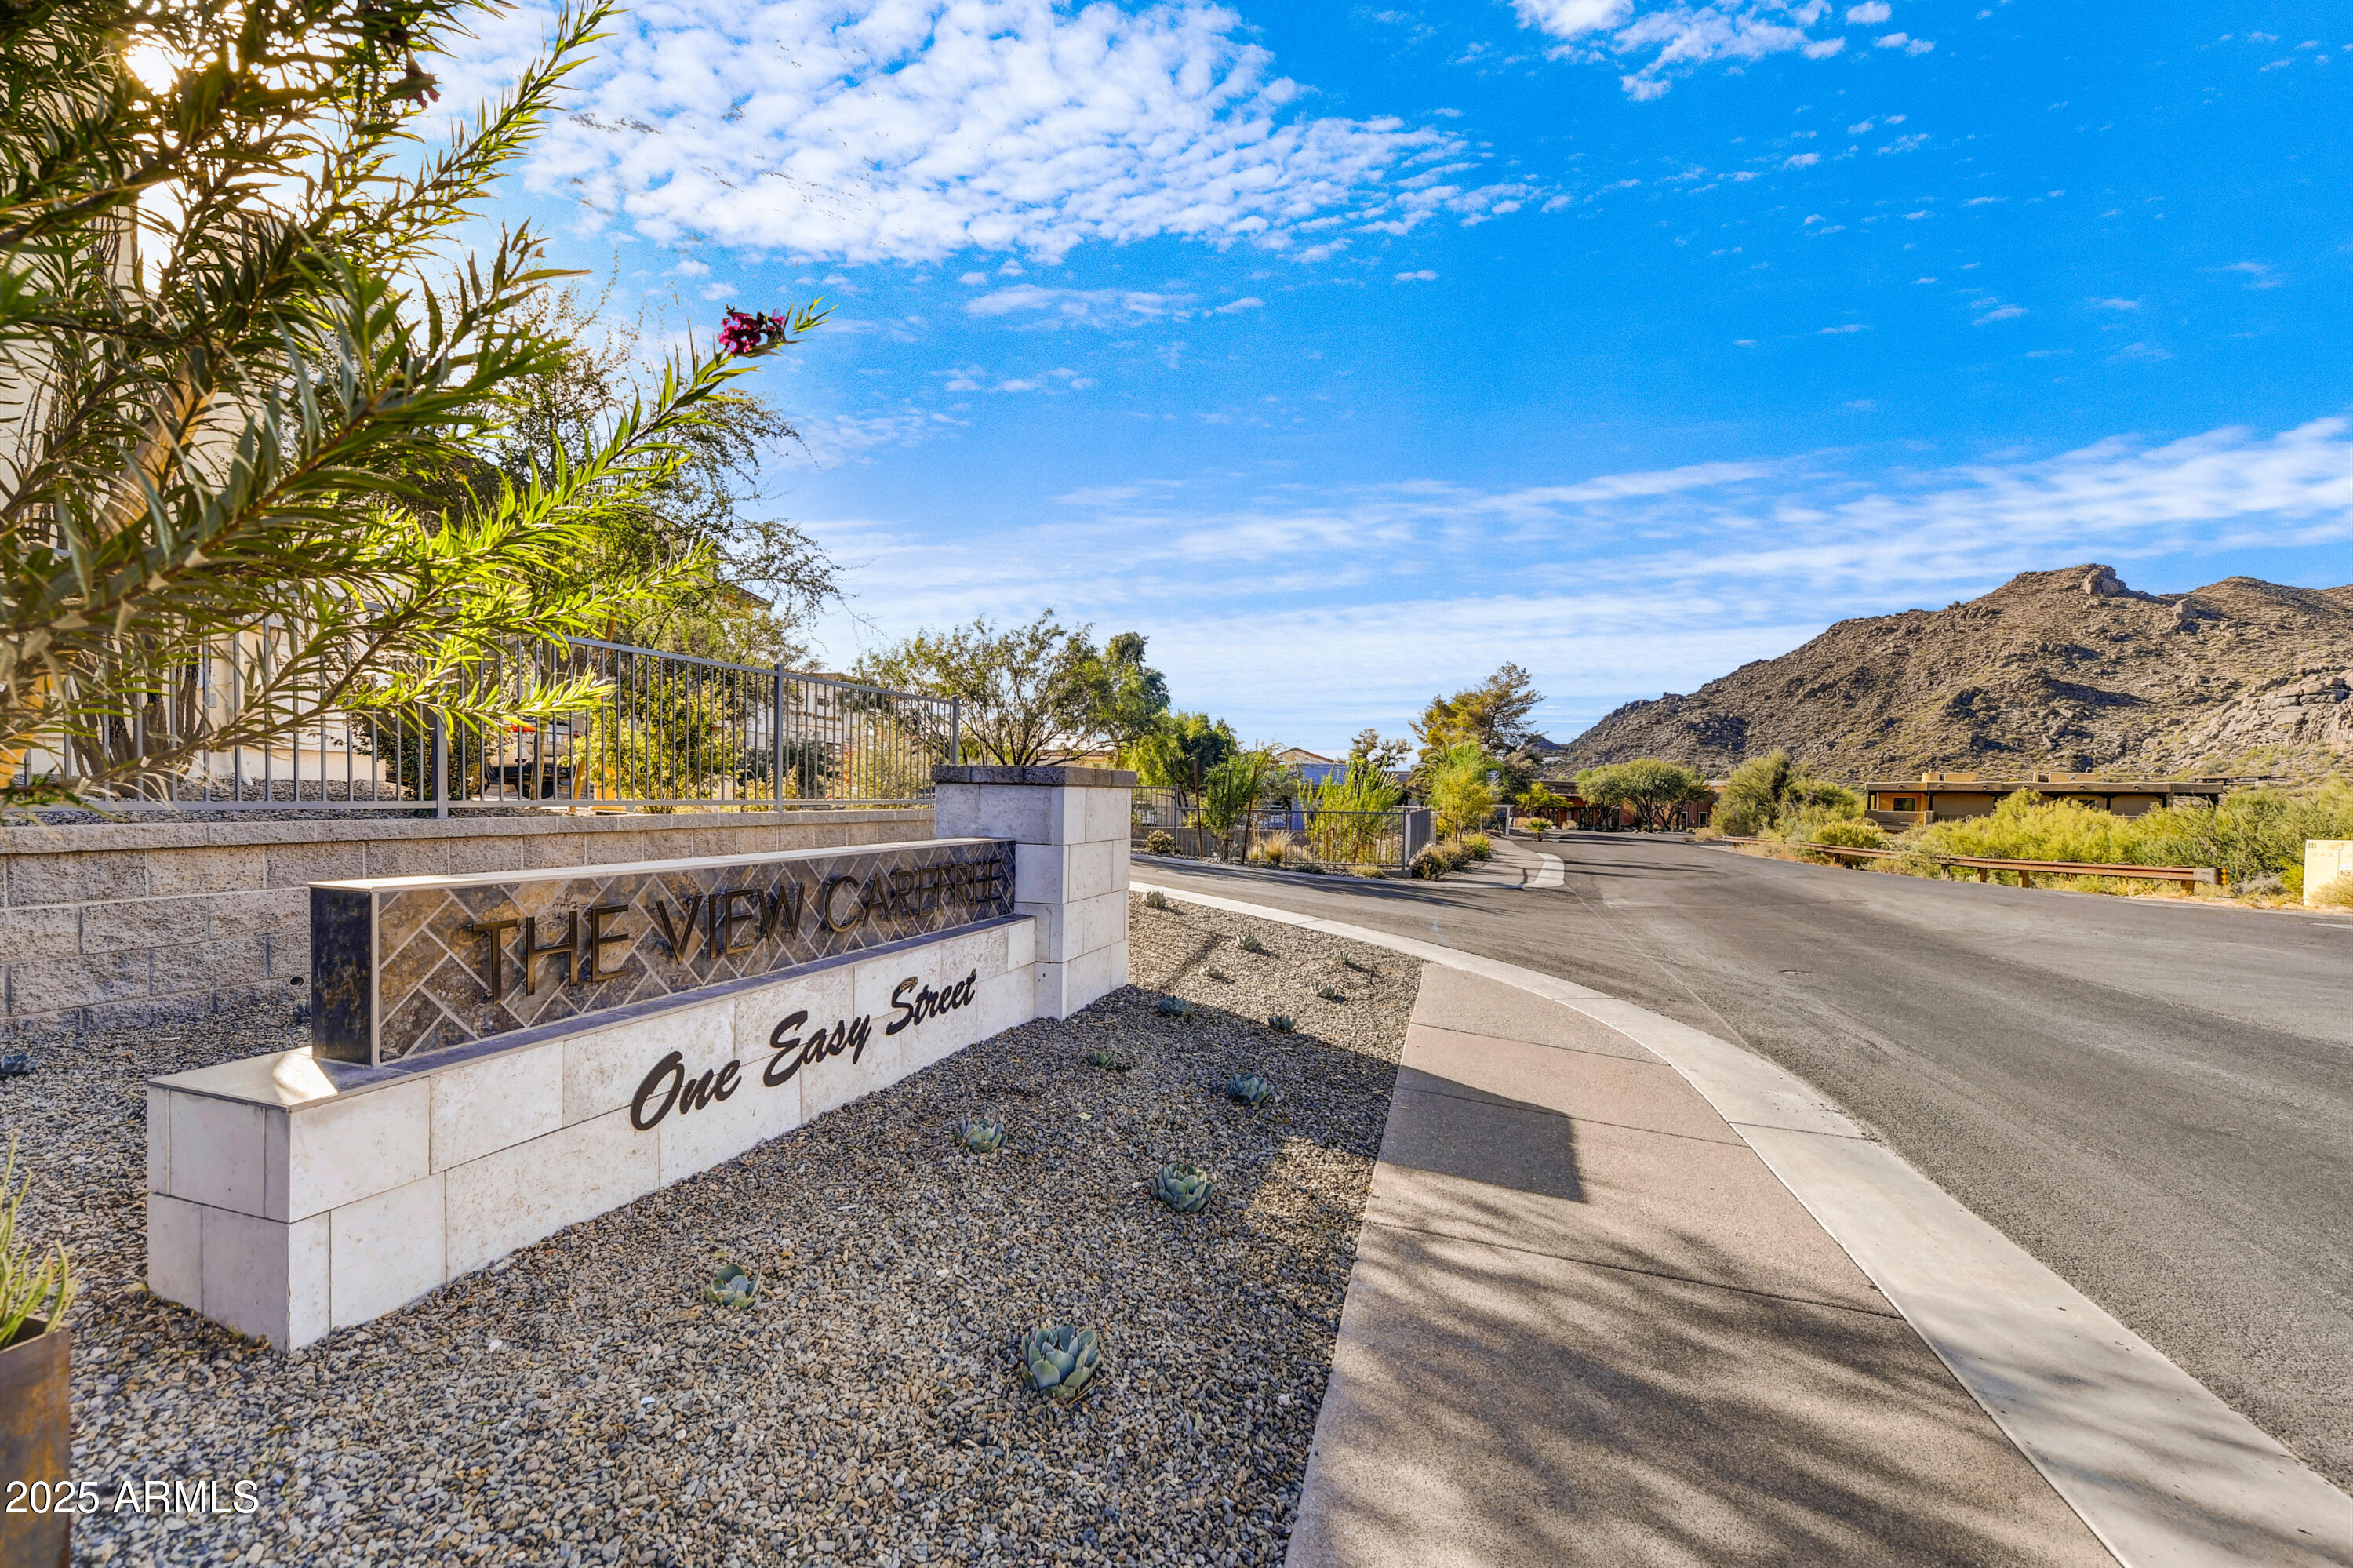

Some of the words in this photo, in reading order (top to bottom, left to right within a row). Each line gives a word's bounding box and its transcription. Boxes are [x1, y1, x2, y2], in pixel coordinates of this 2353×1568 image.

[472, 904, 629, 1005] THE
[654, 882, 806, 966] VIEW
[824, 858, 1002, 934] CAREFREE
[630, 1050, 742, 1131] One
[762, 1010, 872, 1088] Easy
[885, 967, 977, 1036] Street
